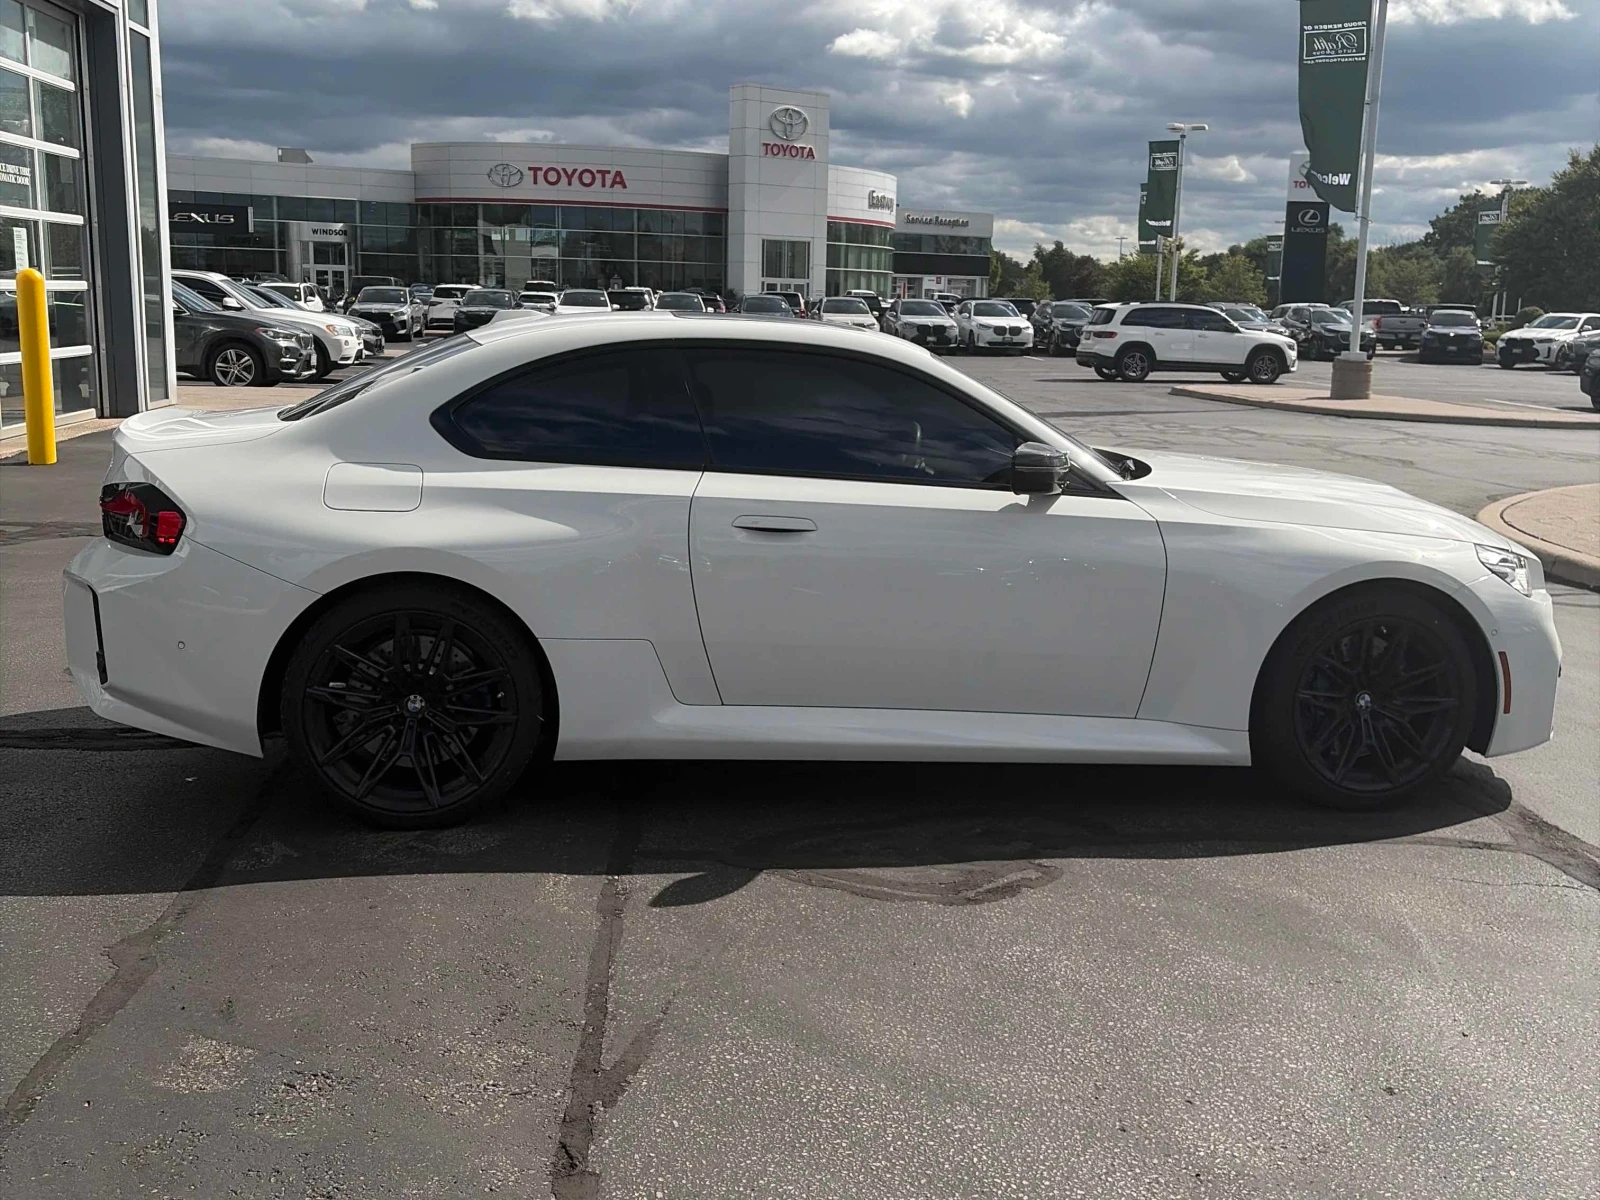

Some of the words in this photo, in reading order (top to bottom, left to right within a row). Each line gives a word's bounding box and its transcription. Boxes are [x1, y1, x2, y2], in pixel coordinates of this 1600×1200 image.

[762, 142, 815, 160] TOYOTA
[528, 166, 627, 189] TOYOTA
[905, 214, 933, 225] Service
[934, 216, 969, 228] Reception
[311, 228, 348, 237] WINDSOR
